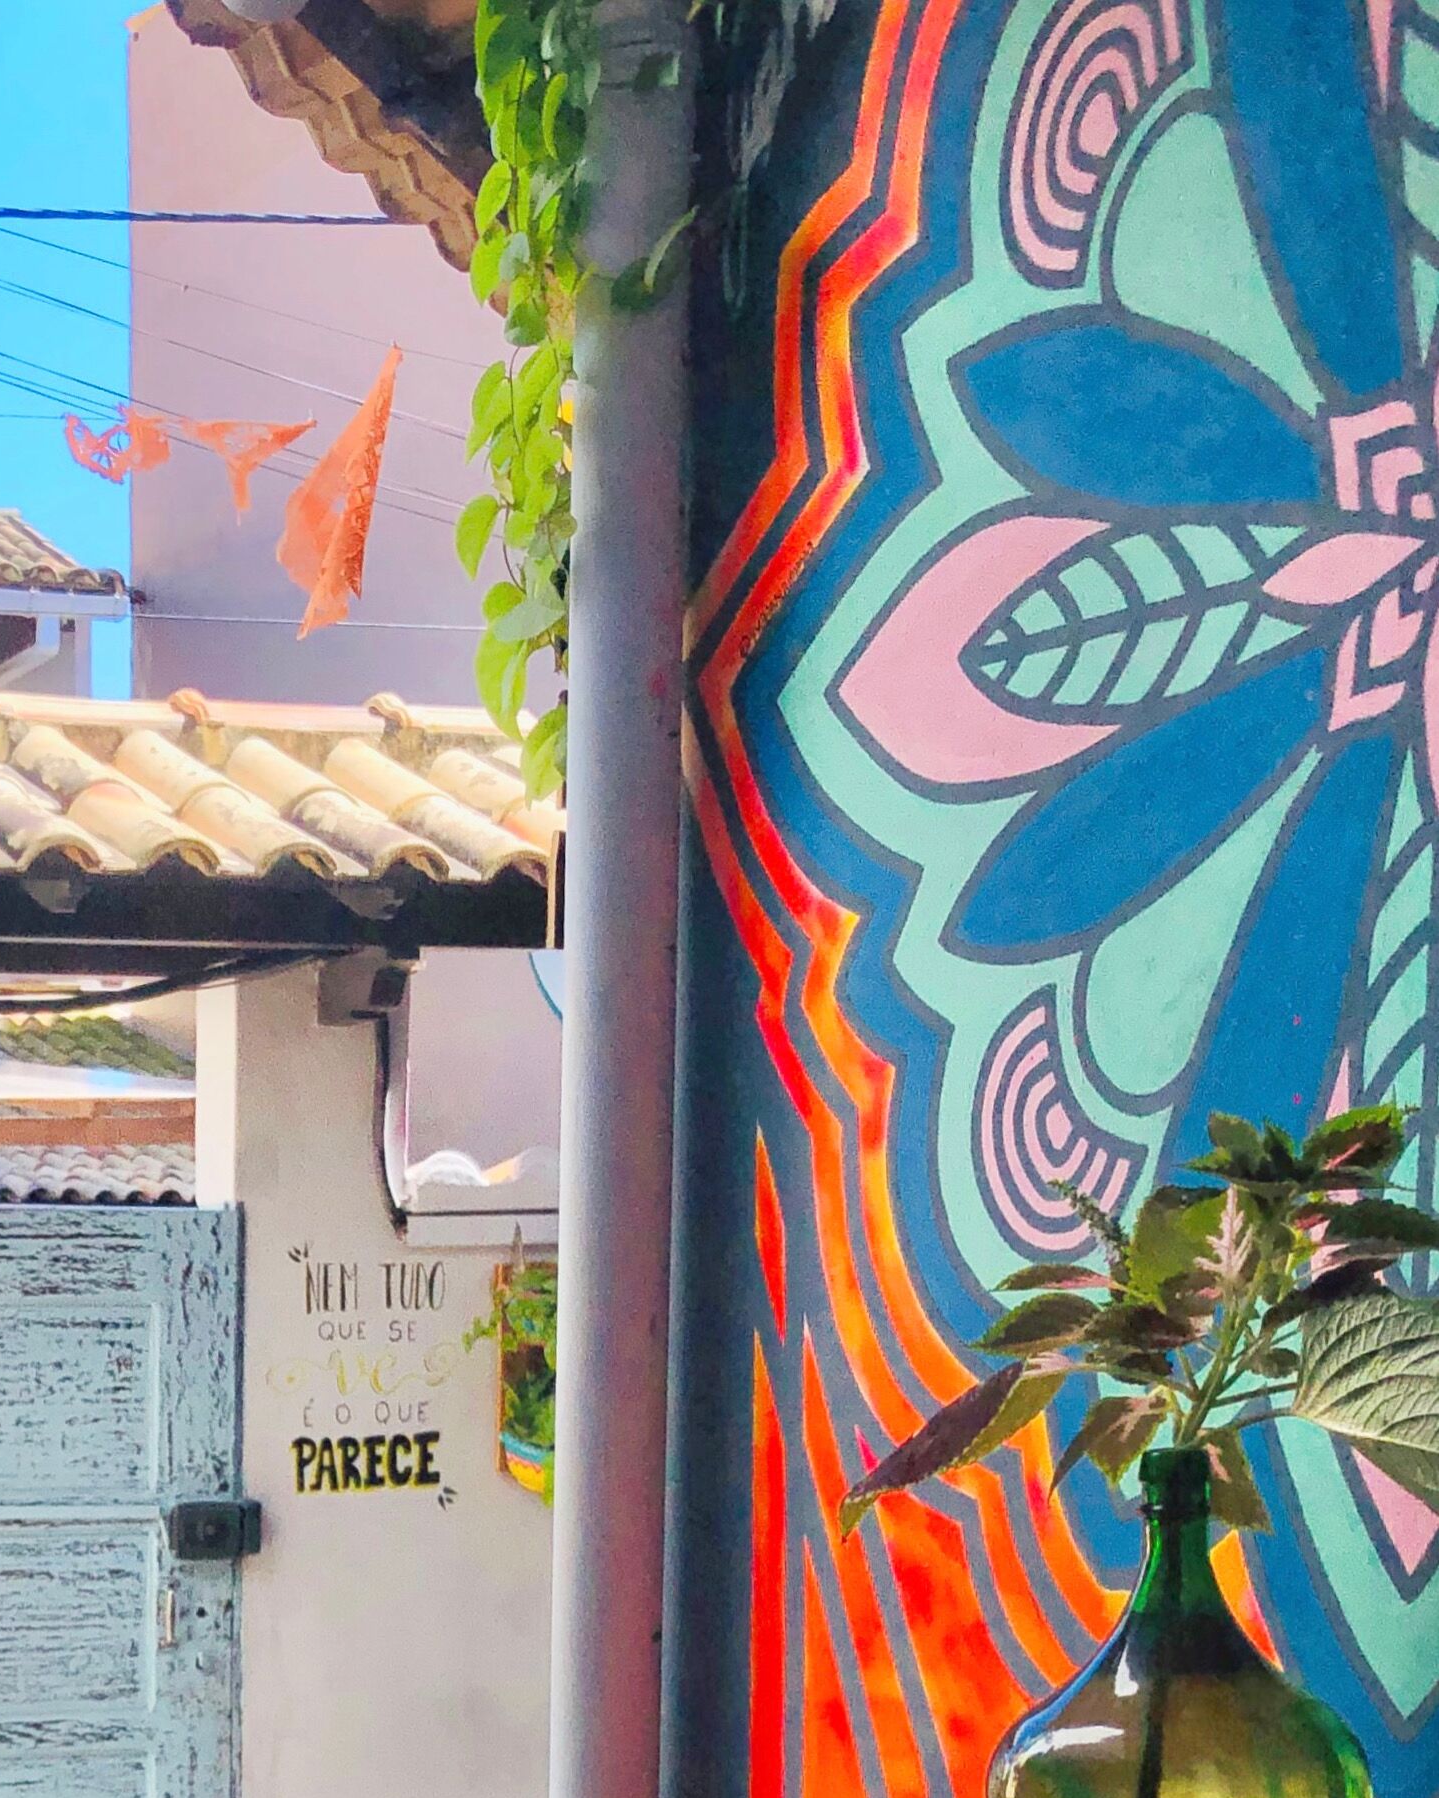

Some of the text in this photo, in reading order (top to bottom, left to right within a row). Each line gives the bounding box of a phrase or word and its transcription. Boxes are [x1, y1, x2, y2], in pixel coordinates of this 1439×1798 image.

[305, 1260, 446, 1314] NEM TUDO
[318, 1319, 417, 1342] QUE SE
[302, 1398, 430, 1428] É O QUE
[290, 1430, 441, 1495] PARECE
